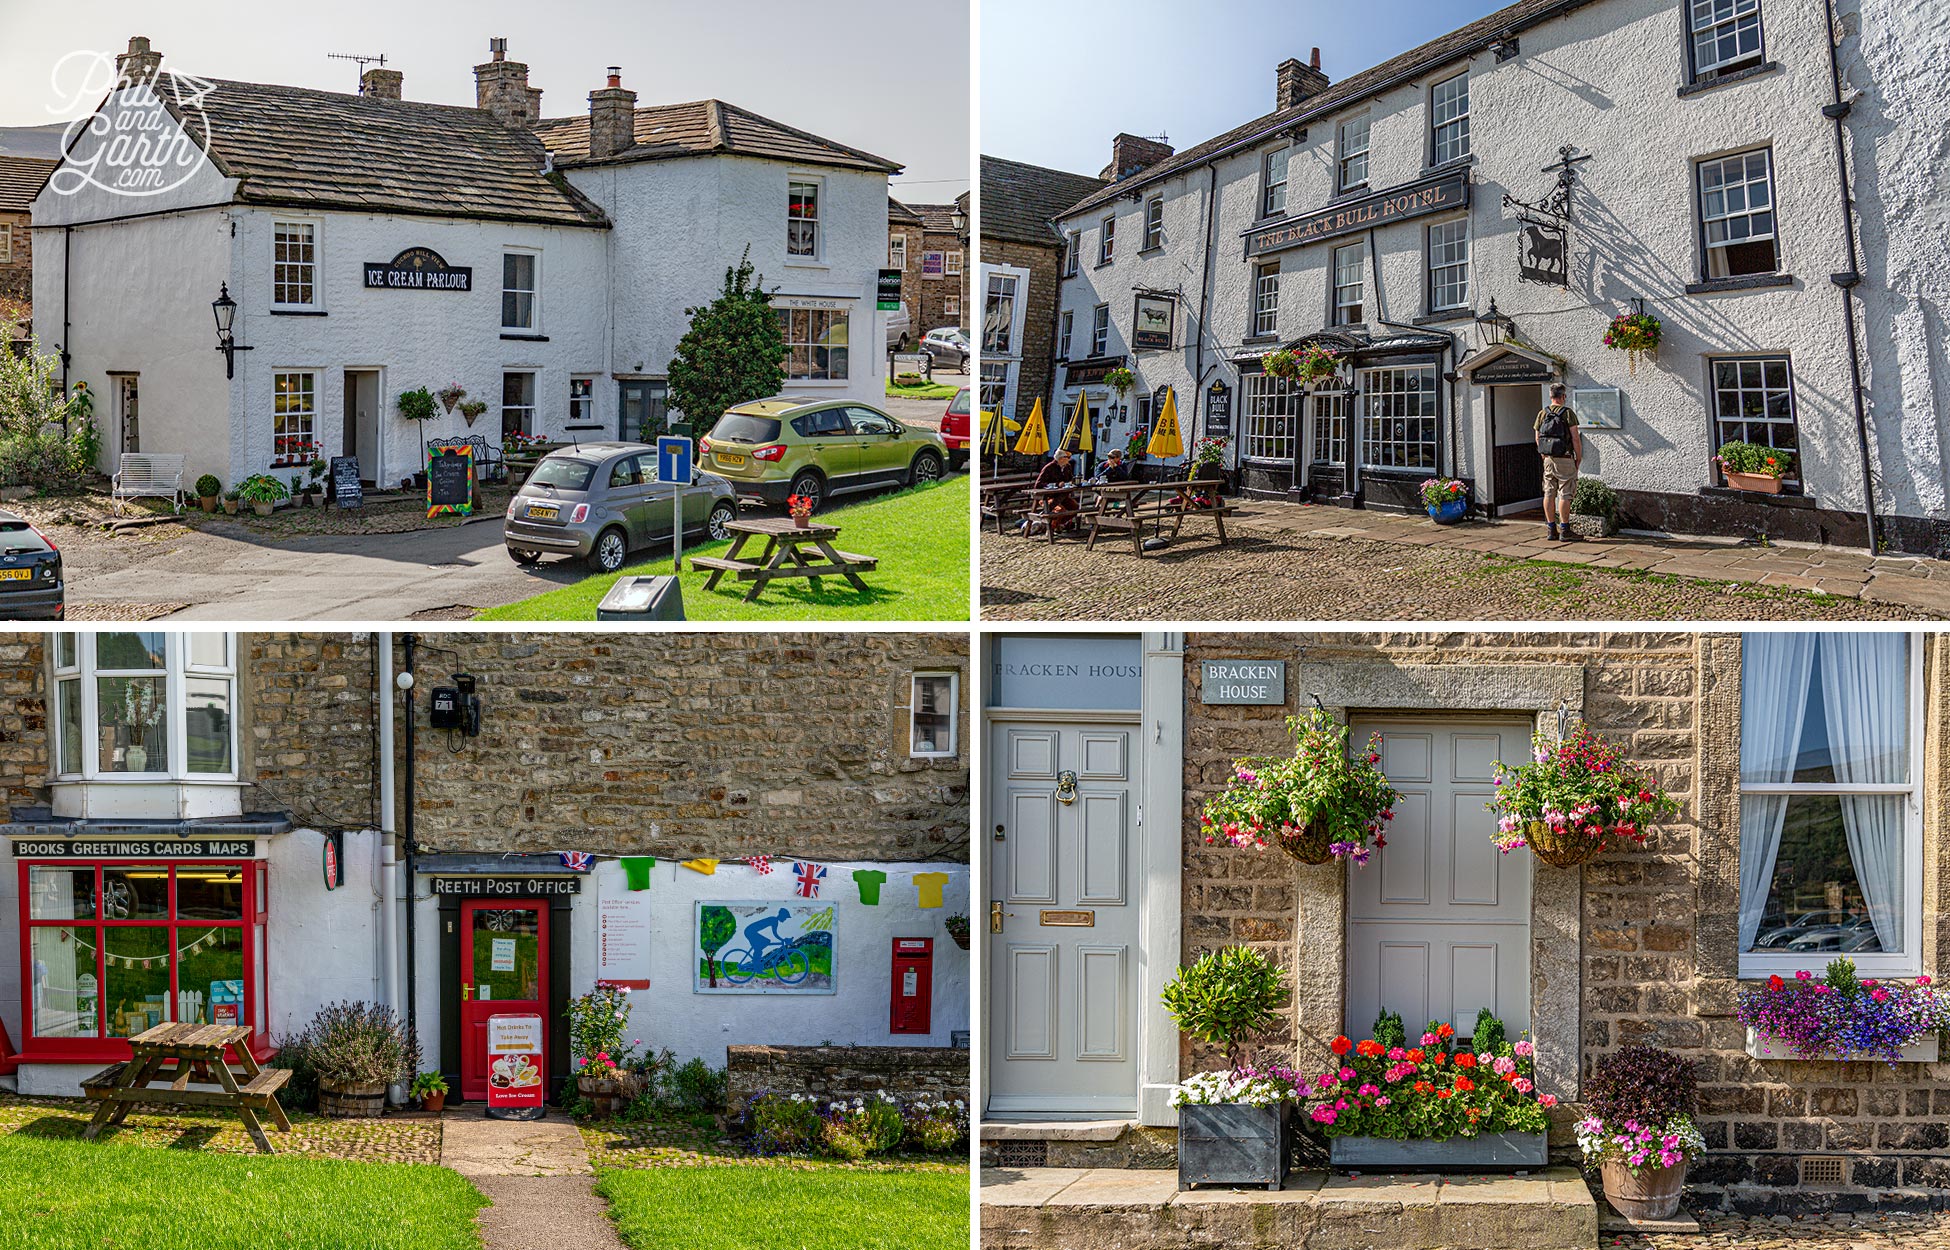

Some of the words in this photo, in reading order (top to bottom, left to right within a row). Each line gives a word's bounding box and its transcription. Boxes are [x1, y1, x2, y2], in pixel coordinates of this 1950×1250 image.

[1257, 231, 1284, 249] THE
[1287, 216, 1333, 241] BLACK
[1336, 206, 1378, 229] BULL
[1383, 186, 1447, 216] HOTEL
[368, 270, 384, 286] ICE
[388, 271, 423, 288] CREAM
[427, 273, 468, 290] PARLOUR
[789, 299, 799, 307] THE
[801, 300, 817, 308] WHITE
[819, 301, 837, 309] HOUSE
[1210, 395, 1228, 404] BLACK
[1212, 403, 1225, 412] BULL
[14, 570, 29, 579] OVJ
[994, 663, 1080, 677] BRACKEN
[1208, 666, 1278, 679] BRACKEN
[1219, 685, 1267, 699] HOUSE
[19, 842, 65, 855] BOOKS
[72, 842, 151, 855] GREETINGS
[154, 842, 202, 855] CARDS
[209, 842, 249, 855] MAPS
[435, 878, 481, 894] REETH
[486, 878, 522, 894] POST
[527, 878, 576, 894] OFFICE
[517, 1091, 536, 1099] Cream
